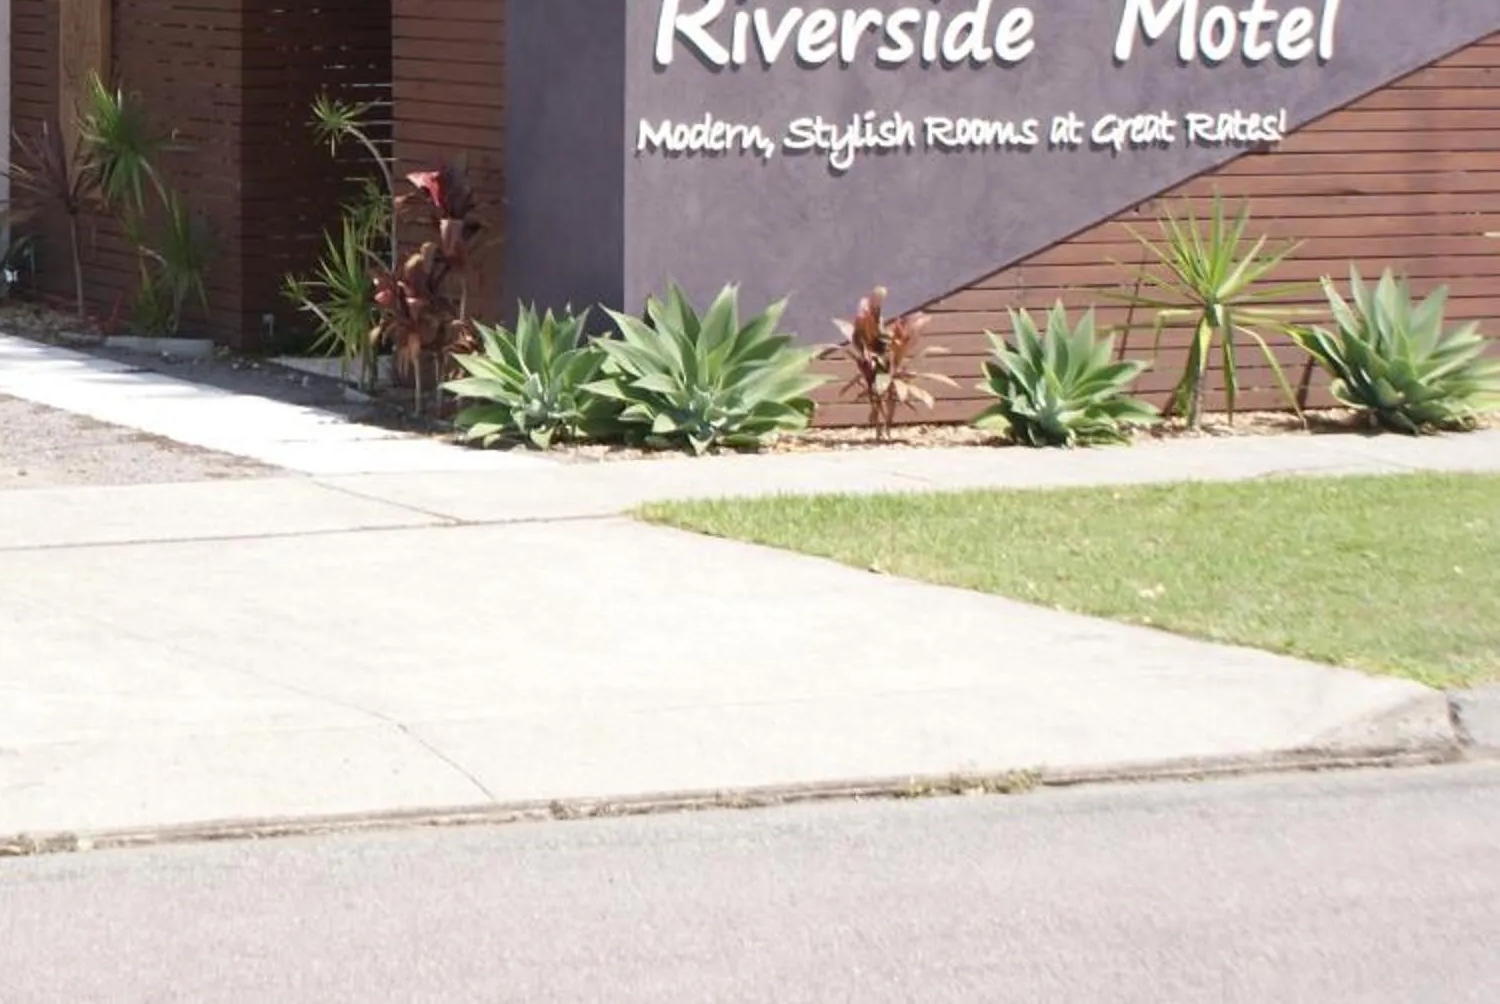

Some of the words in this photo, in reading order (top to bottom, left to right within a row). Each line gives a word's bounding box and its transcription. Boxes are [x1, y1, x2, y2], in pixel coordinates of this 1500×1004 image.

[637, 111, 776, 159] Modern,
[782, 109, 917, 170] Stylish
[923, 115, 1040, 147] Rooms
[1050, 110, 1086, 145] at
[1091, 109, 1178, 152] Great
[1184, 108, 1288, 142] Rates!
